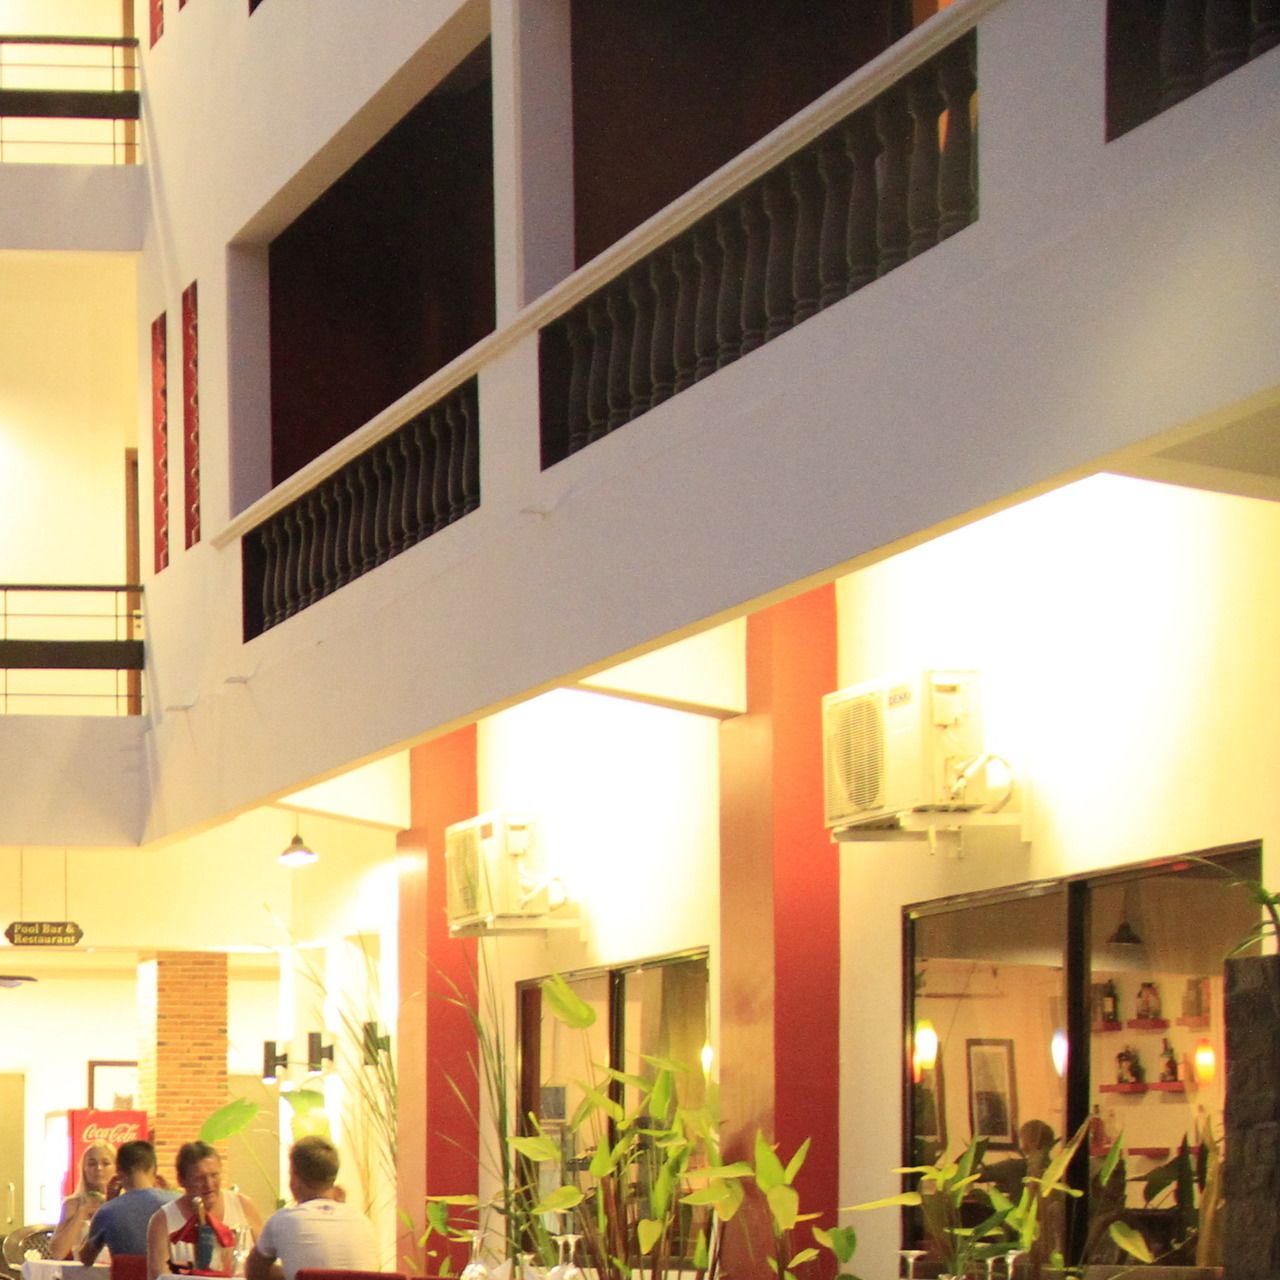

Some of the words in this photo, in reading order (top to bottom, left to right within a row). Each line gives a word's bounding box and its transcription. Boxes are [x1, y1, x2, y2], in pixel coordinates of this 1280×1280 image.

[14, 923, 39, 934] Pool
[42, 923, 63, 934] Bar
[65, 923, 75, 934] &
[14, 934, 76, 944] Restaurant
